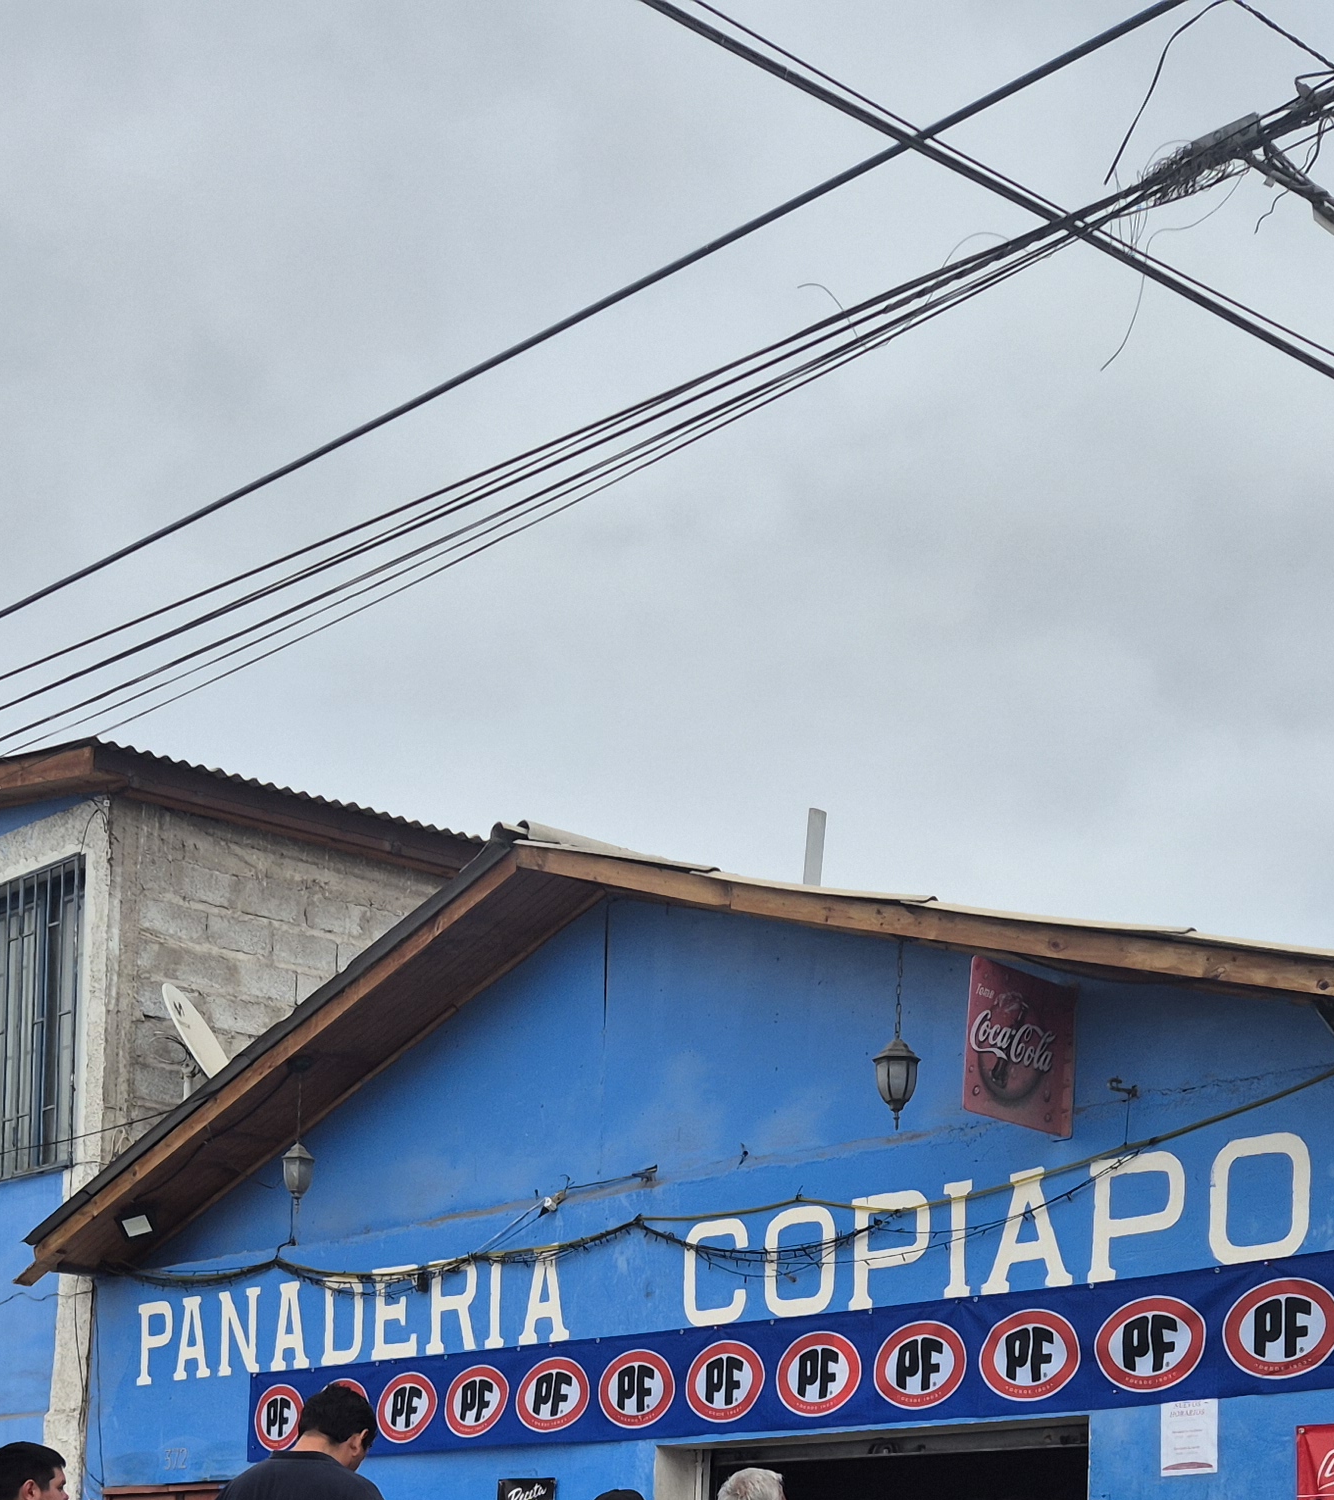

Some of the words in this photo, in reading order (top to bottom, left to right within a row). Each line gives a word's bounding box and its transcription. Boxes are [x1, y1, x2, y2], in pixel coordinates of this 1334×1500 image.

[969, 1009, 1057, 1072] Coca-Cola
[136, 1245, 570, 1386] PANADERIA
[683, 1131, 1311, 1328] COPIAPO
[266, 1397, 291, 1438] PF
[391, 1386, 422, 1428] PF
[460, 1379, 493, 1423] PF
[533, 1371, 572, 1417] PF
[617, 1365, 654, 1412] PF
[705, 1356, 743, 1406] PF
[797, 1348, 839, 1399] PF
[896, 1337, 943, 1391] PF
[1005, 1326, 1054, 1383] PF
[1122, 1314, 1178, 1372] PF
[1254, 1296, 1311, 1358] PF
[164, 1447, 188, 1471] 372
